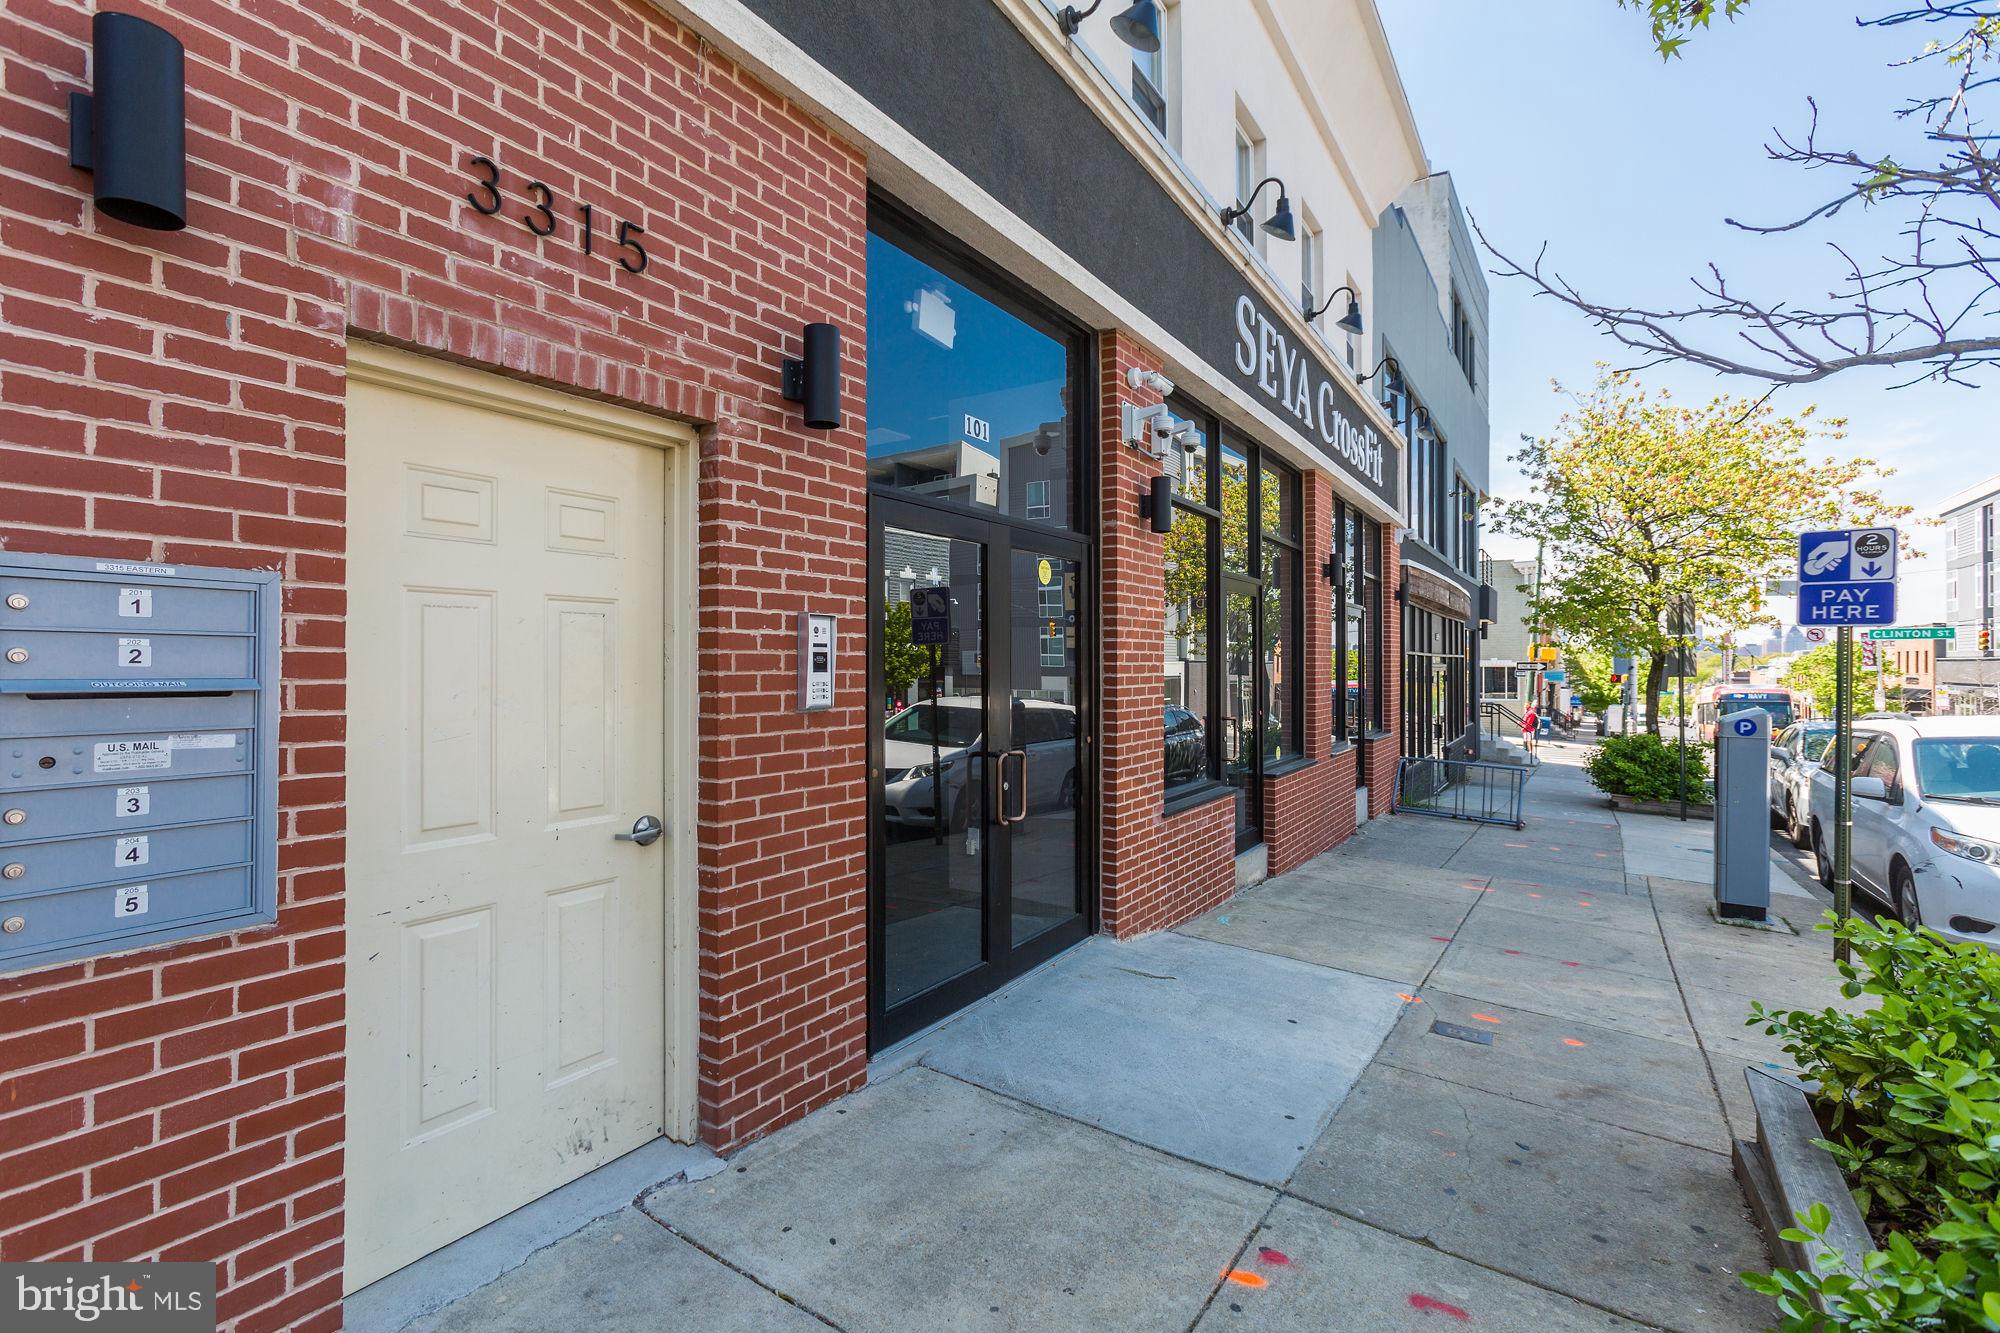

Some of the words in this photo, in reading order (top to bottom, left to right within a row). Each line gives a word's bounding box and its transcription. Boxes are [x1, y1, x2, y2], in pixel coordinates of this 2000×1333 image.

[468, 157, 648, 273] 3315
[1235, 295, 1314, 430] SEYA
[1318, 381, 1383, 488] CrossFit
[966, 416, 988, 441] 101
[1866, 534, 1878, 545] 2
[1856, 544, 1888, 552] HOURS
[126, 565, 167, 574] EASTERN
[1821, 588, 1870, 603] PAY
[131, 599, 140, 614] 1
[1812, 604, 1880, 620] HERE
[1872, 629, 1931, 638] CLINTON
[128, 648, 142, 664] 2
[107, 743, 130, 752] U.S.
[132, 742, 160, 751] MAIL
[127, 797, 140, 813] 3
[125, 847, 140, 862] 4
[124, 887, 140, 895] 205
[125, 896, 138, 912] 5
